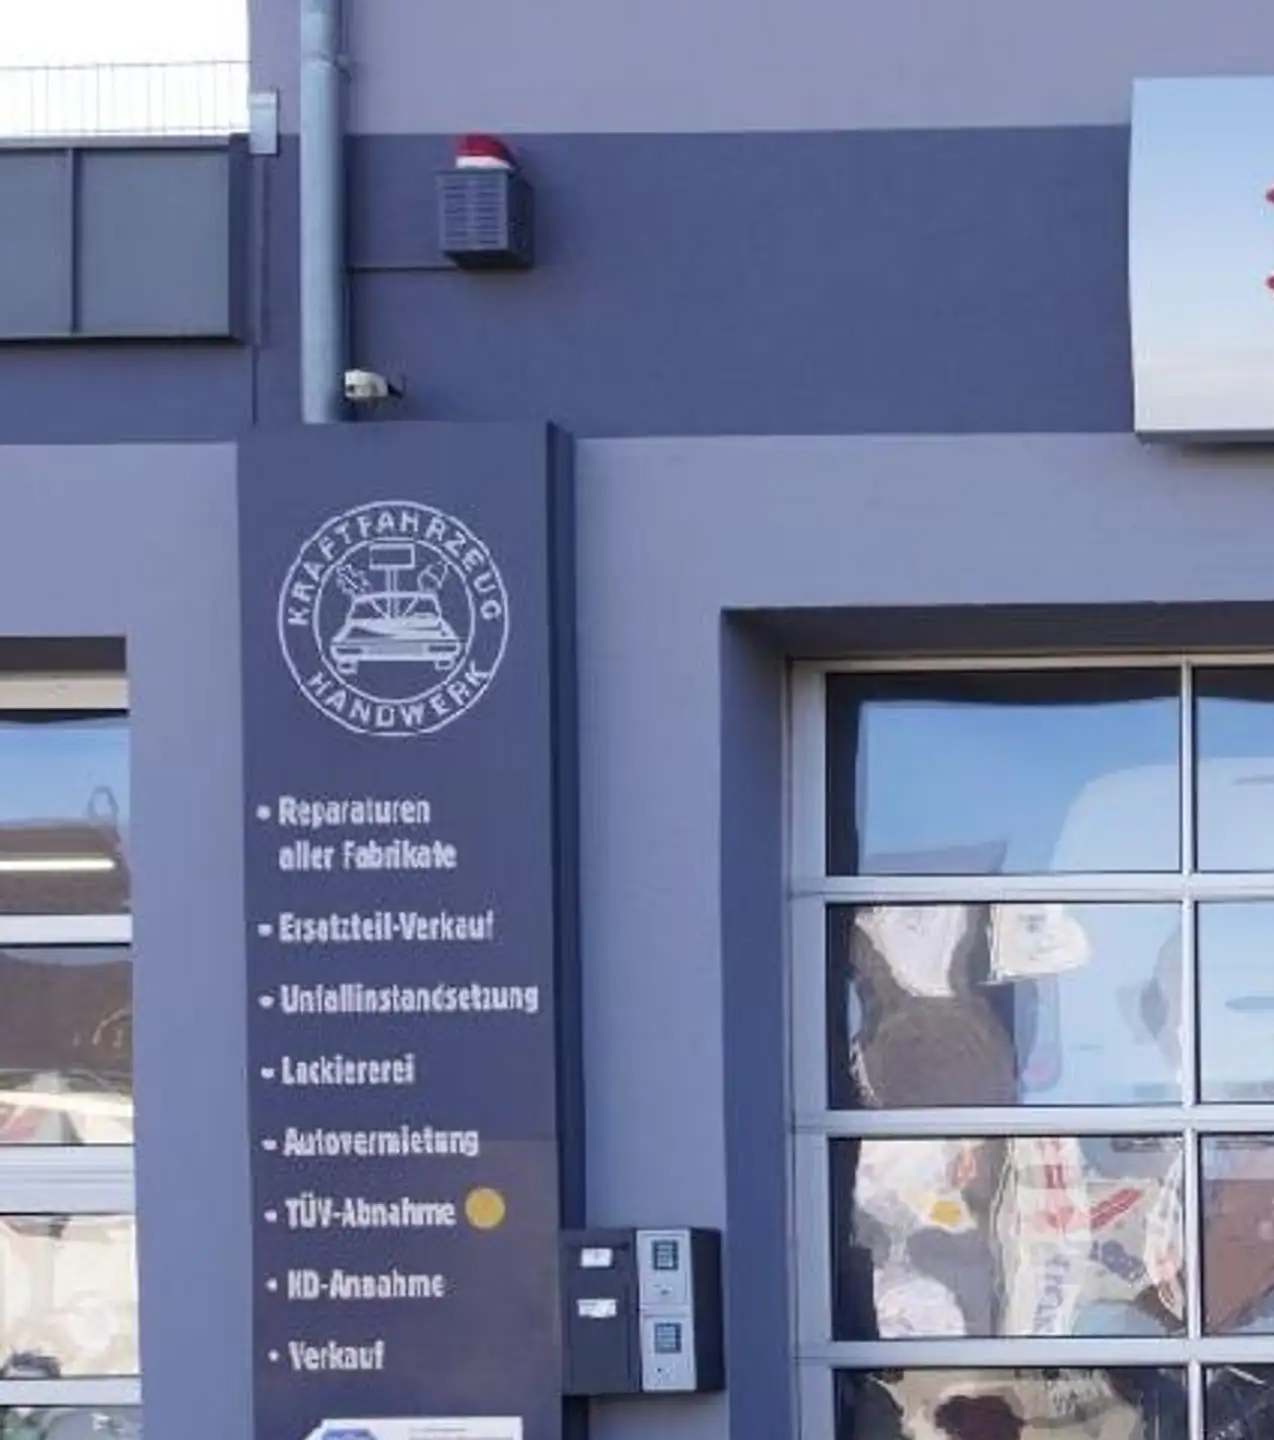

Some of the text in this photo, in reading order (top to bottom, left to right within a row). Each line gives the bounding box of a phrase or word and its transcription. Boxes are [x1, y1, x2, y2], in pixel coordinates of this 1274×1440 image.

[288, 508, 502, 626] KRAFTFAHRZEUG
[305, 658, 492, 728] HANDWERK
[279, 797, 430, 828] Reparaturen
[279, 840, 456, 870] aller Fabrikate
[280, 911, 493, 942] Ersatzteil-Verkauf
[281, 984, 538, 1013] Unfallinstandsetzung
[282, 1054, 414, 1084] Lackiererei
[284, 1126, 479, 1156] Autovermietung
[285, 1193, 456, 1227] TÜV-Abnahme
[289, 1341, 384, 1370] Verkauf
